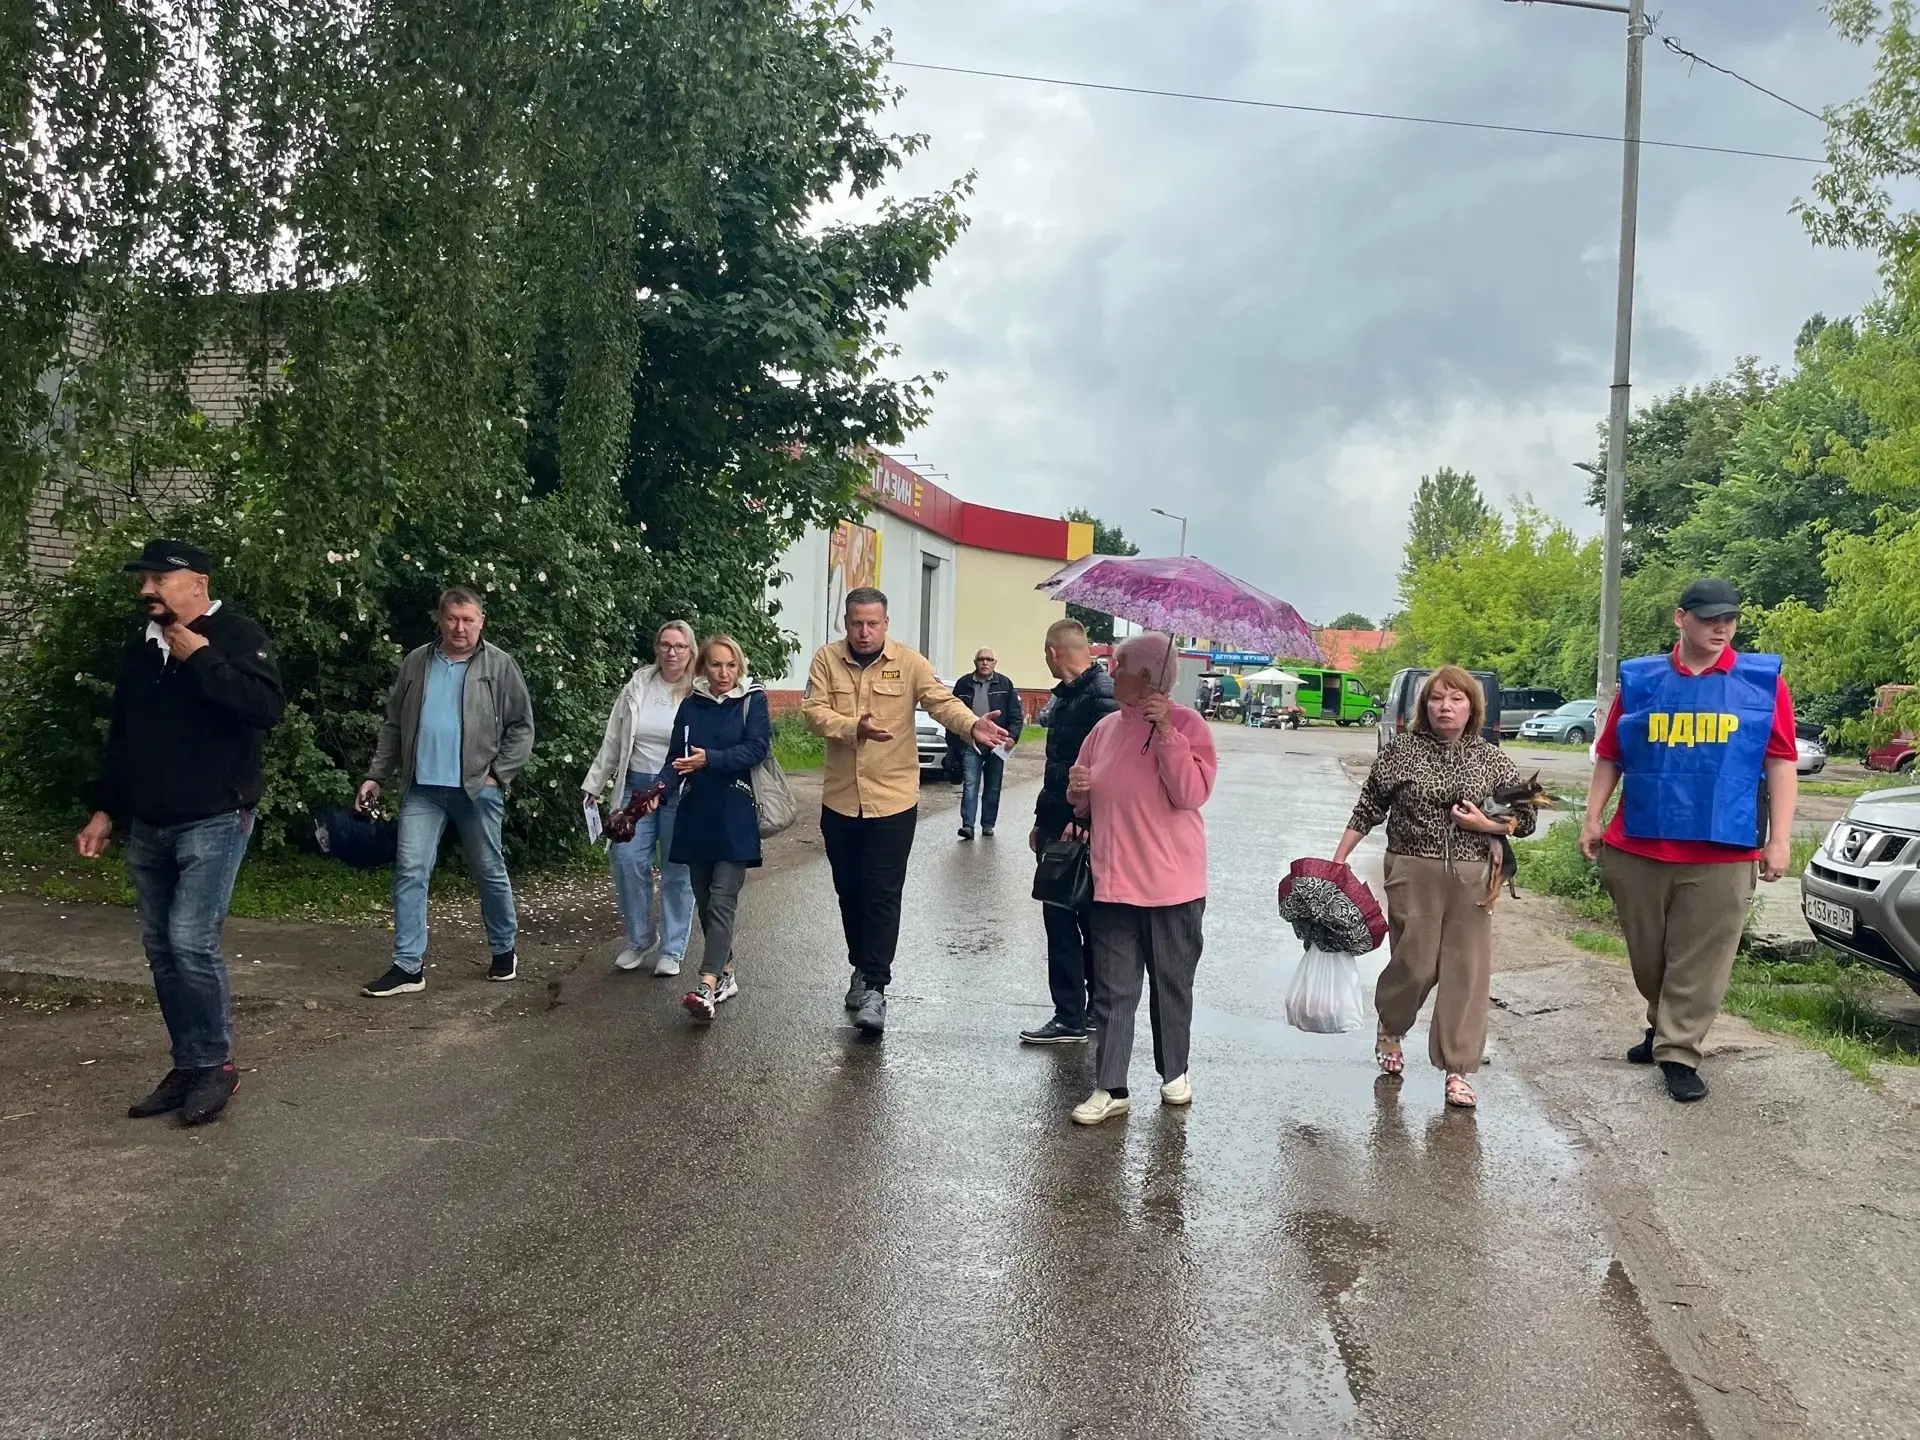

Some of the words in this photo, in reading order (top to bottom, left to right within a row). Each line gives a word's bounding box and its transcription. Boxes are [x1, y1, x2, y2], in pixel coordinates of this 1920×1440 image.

[863, 459, 912, 507] ГАЗИН
[1648, 712, 1739, 748] ЛДПР
[1840, 907, 1850, 923] 39
